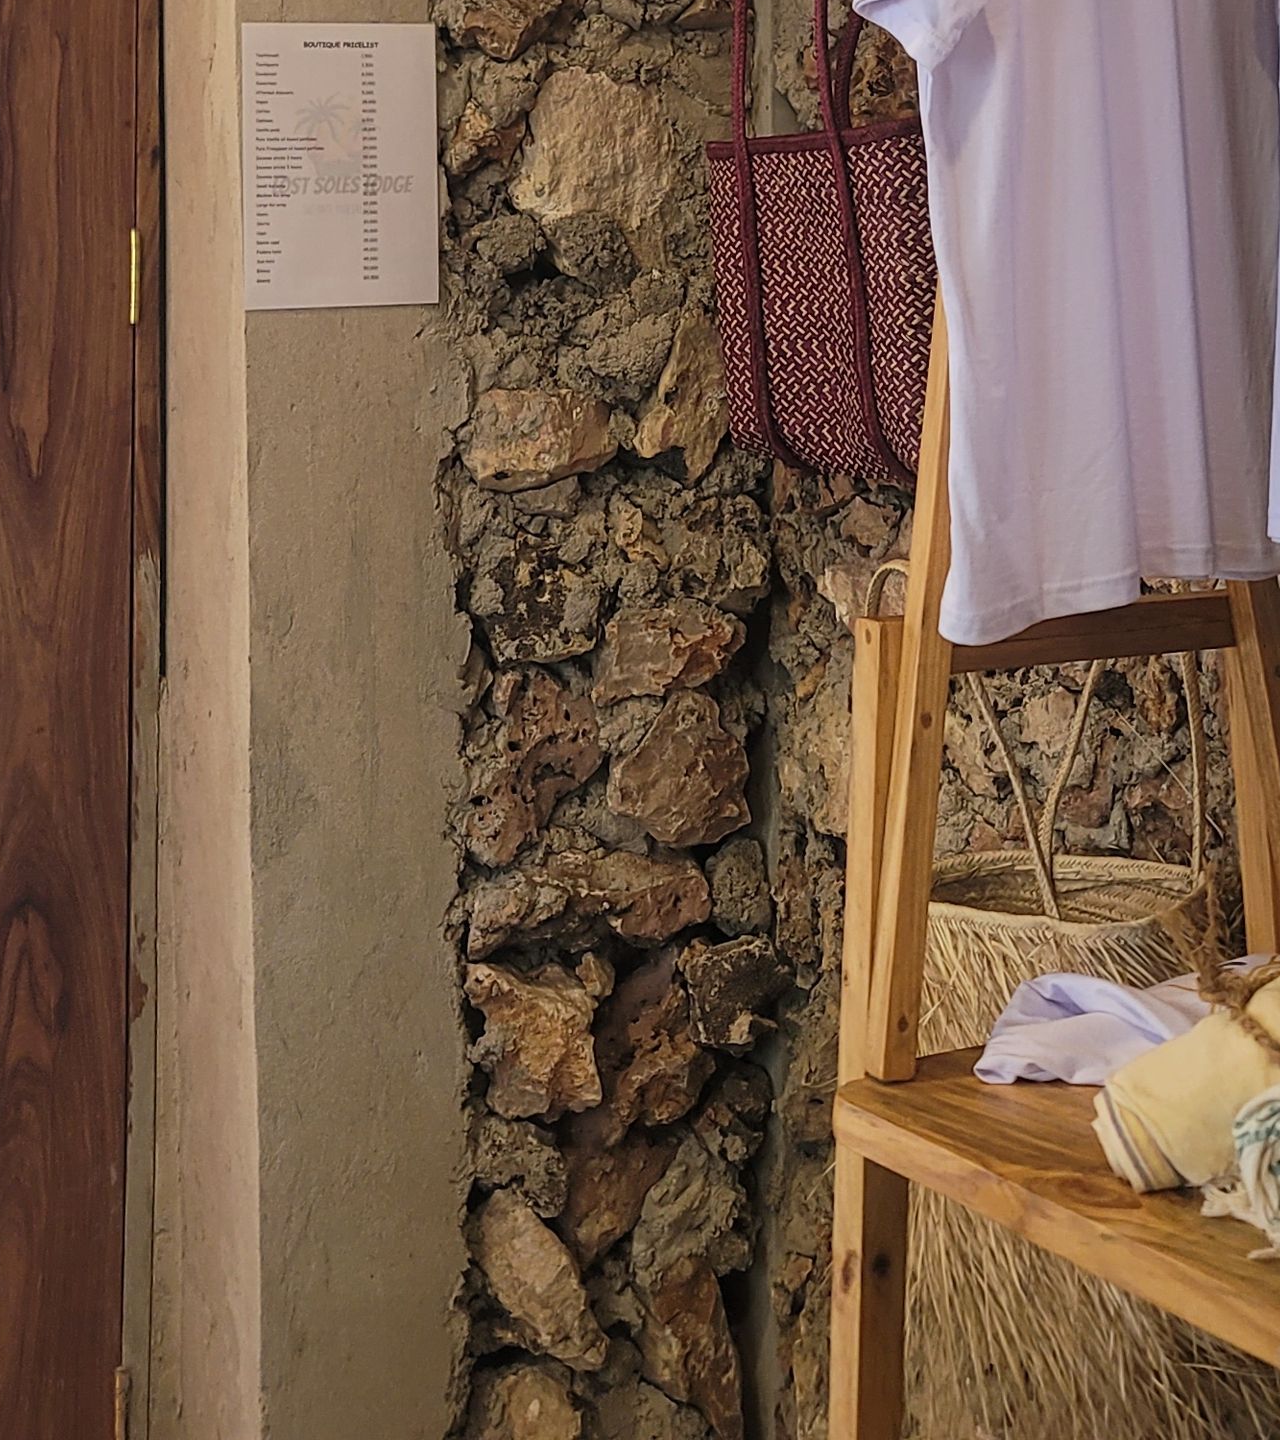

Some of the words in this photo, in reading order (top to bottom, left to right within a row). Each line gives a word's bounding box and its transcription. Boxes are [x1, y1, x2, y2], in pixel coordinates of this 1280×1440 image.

[303, 41, 341, 49] BOUTIQUE
[342, 41, 379, 49] PRICELIST
[313, 175, 361, 195] SOLES
